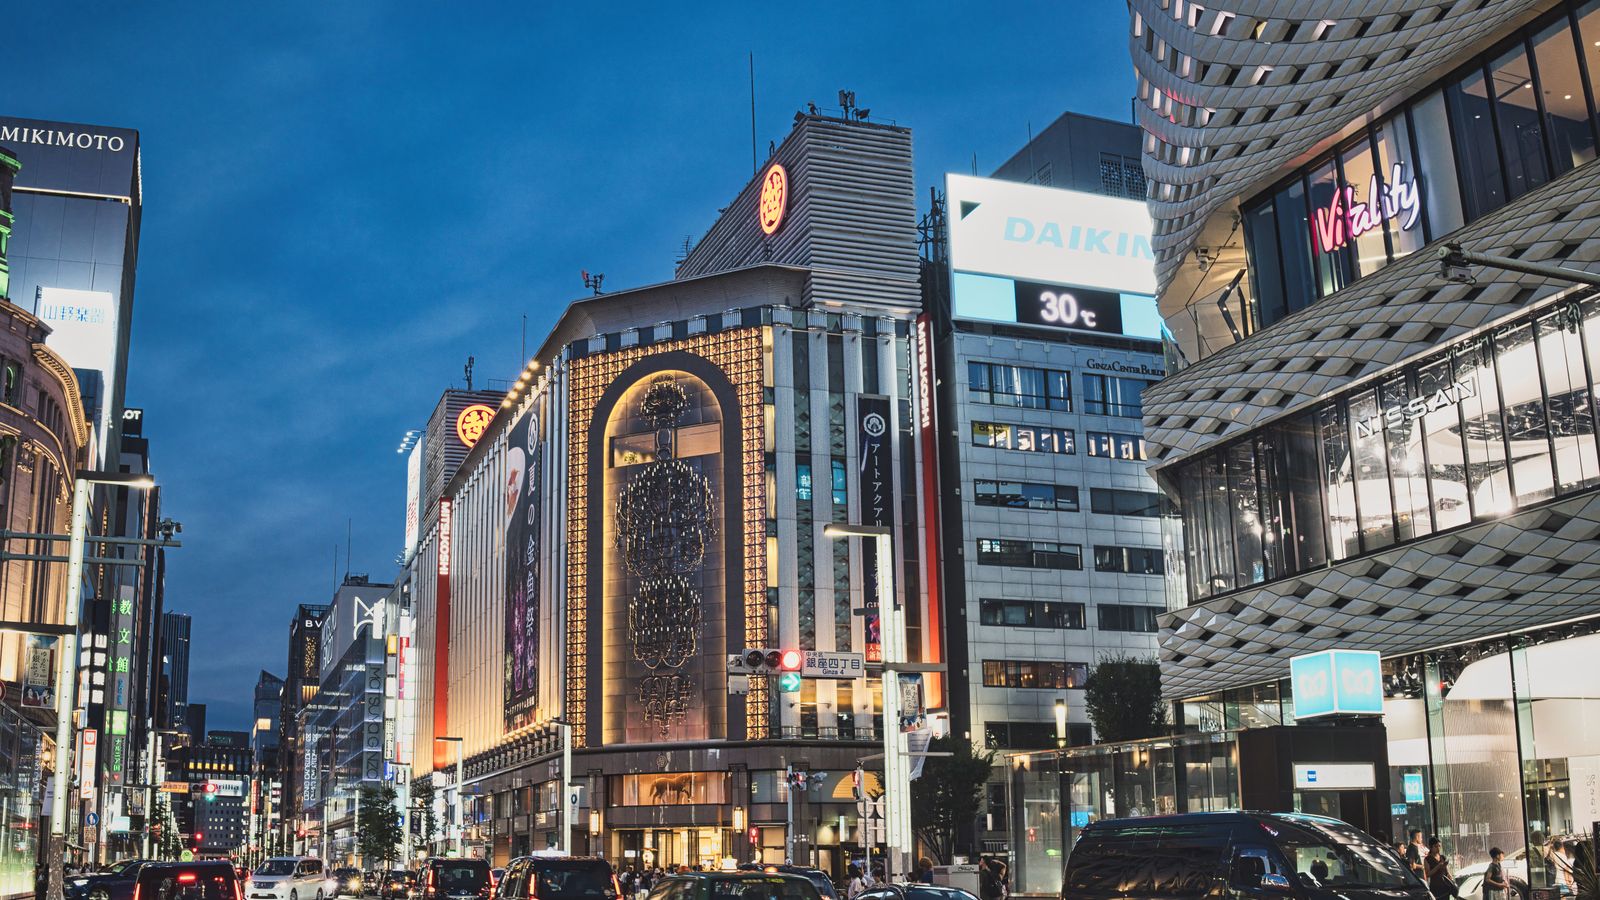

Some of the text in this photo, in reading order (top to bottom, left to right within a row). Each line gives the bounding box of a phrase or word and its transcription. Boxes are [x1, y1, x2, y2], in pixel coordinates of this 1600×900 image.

[0, 126, 124, 152] MIKIMOTO
[1316, 162, 1420, 253] Vitality
[1003, 216, 1153, 261] DAIKIN
[917, 321, 930, 428] MITSUKOSHI
[1086, 359, 1112, 371] GINZA
[122, 409, 142, 420] OT
[1355, 376, 1476, 441] NISSAN
[439, 501, 451, 575] MITSUKOSHI
[115, 599, 132, 673] 教文館
[806, 658, 860, 669] 銀座四丁目
